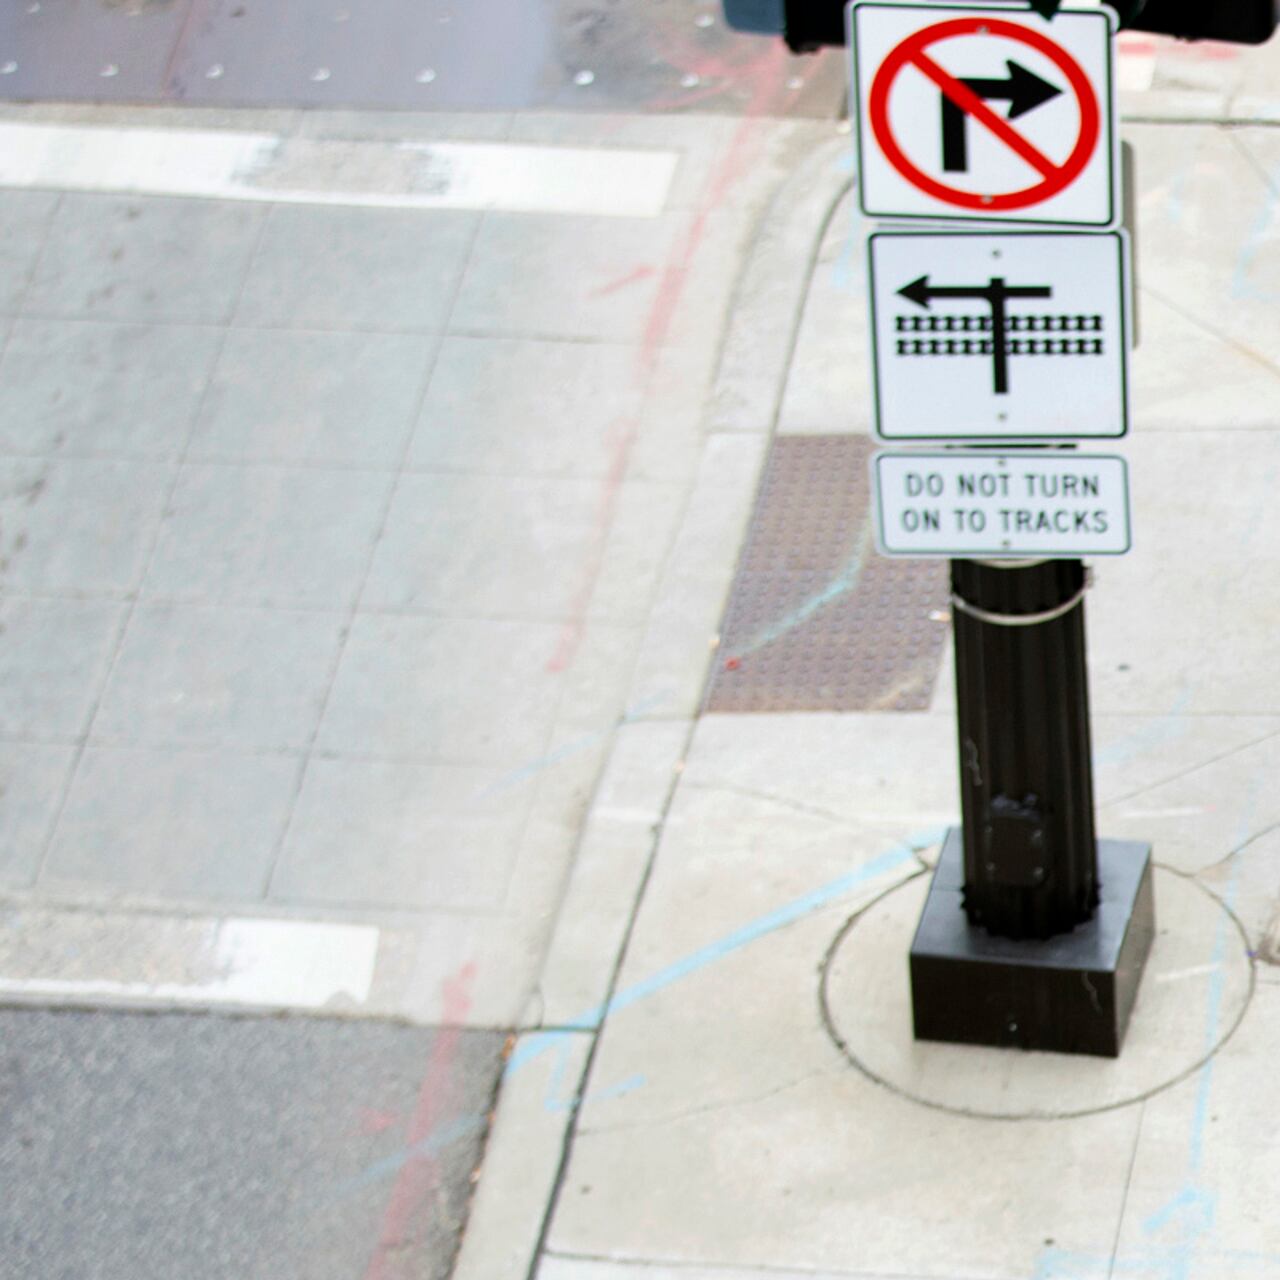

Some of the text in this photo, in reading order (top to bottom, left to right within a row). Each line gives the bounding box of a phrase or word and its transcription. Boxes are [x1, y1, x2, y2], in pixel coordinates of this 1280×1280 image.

[904, 473, 1100, 498] DO NOT TURN
[901, 509, 1109, 533] ON TO TRACKS
